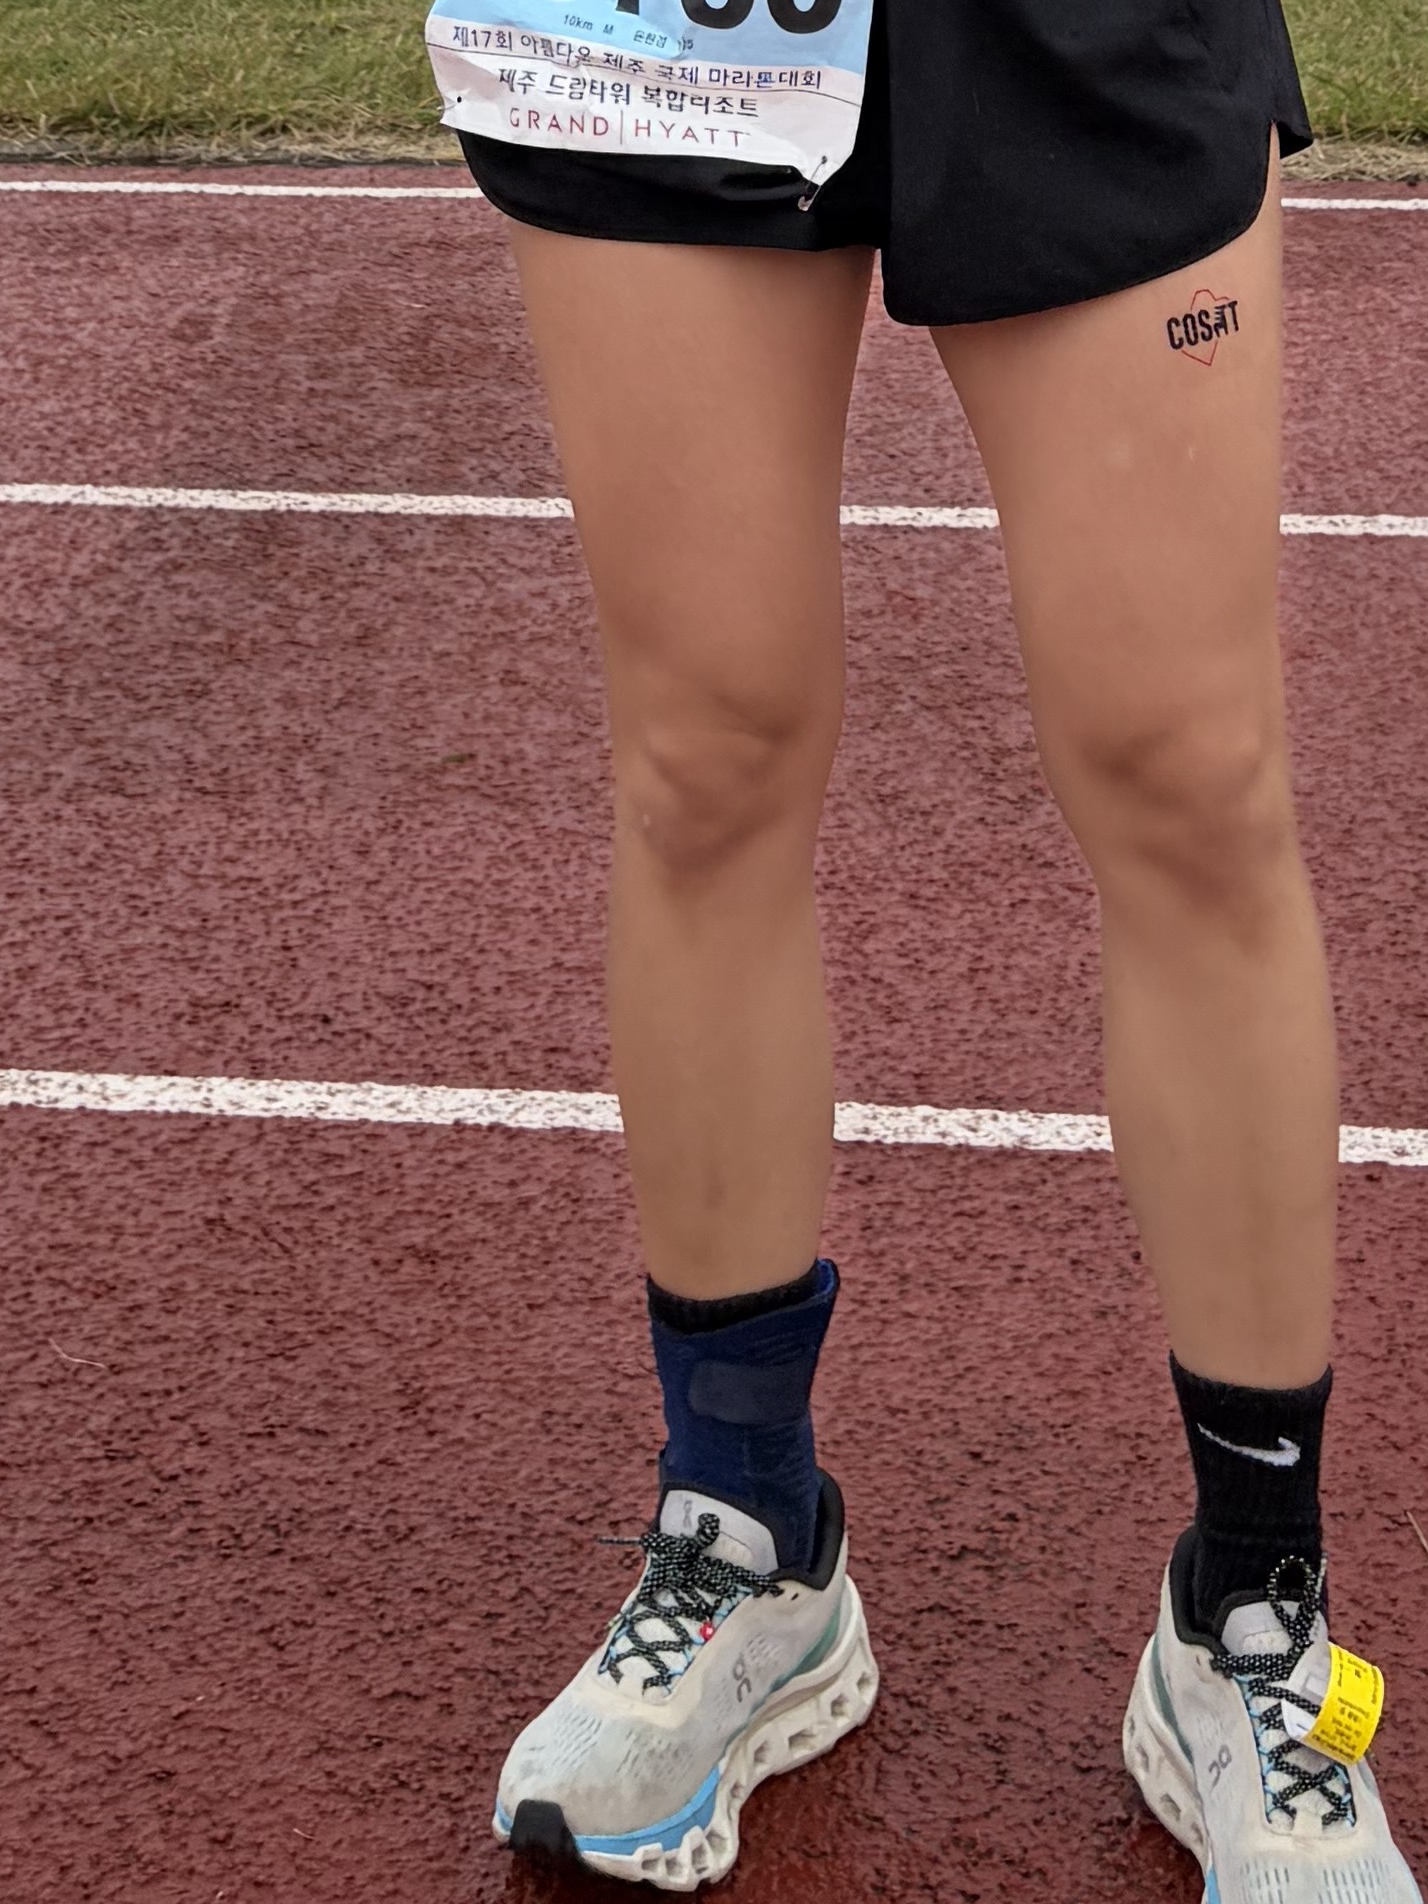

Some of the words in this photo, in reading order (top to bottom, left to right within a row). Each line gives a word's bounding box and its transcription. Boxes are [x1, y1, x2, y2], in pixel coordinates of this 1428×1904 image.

[563, 14, 594, 31] 10km
[453, 26, 513, 52] 제17회
[603, 52, 646, 75] 제주
[654, 64, 699, 85] 국제
[499, 68, 538, 96] 제주
[546, 74, 631, 106] 드림타워
[641, 85, 759, 118] 복합리조트
[509, 107, 609, 137] GRAND
[634, 118, 751, 147] HYATT
